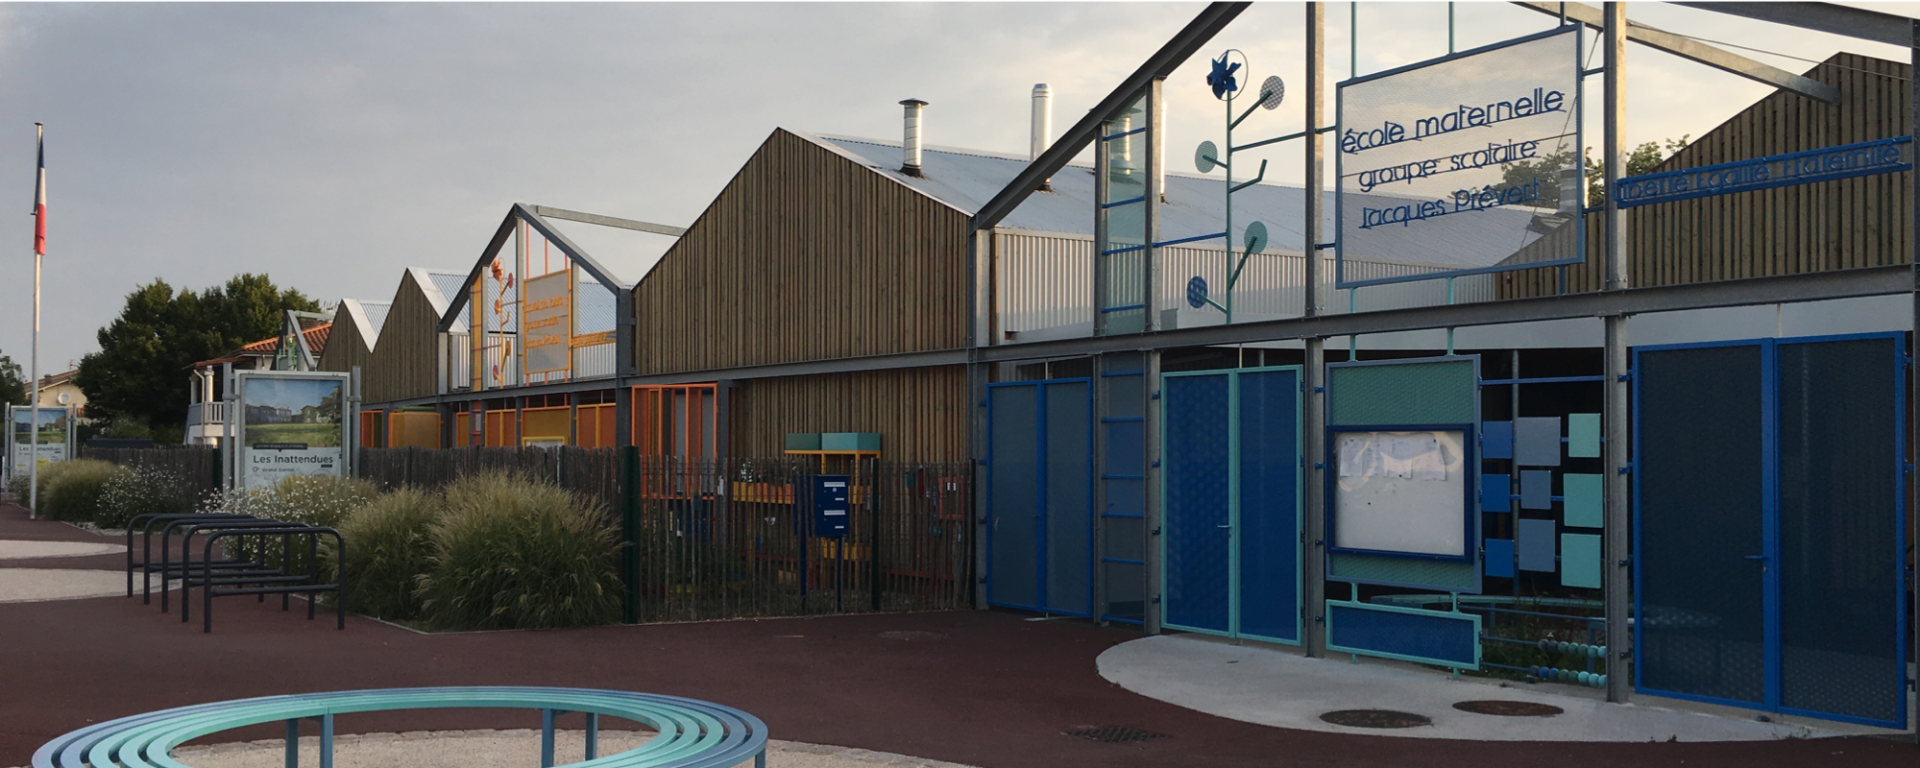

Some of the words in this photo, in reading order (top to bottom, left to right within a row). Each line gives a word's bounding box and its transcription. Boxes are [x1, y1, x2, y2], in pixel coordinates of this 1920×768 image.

[1342, 121, 1405, 154] école
[1415, 87, 1566, 139] maternelle
[1358, 158, 1437, 193] groupe
[1450, 138, 1538, 172] scolaire
[1359, 197, 1446, 229] Jacques
[1454, 177, 1541, 212] Prévert
[253, 455, 271, 464] Les
[274, 454, 334, 464] Inattendues
